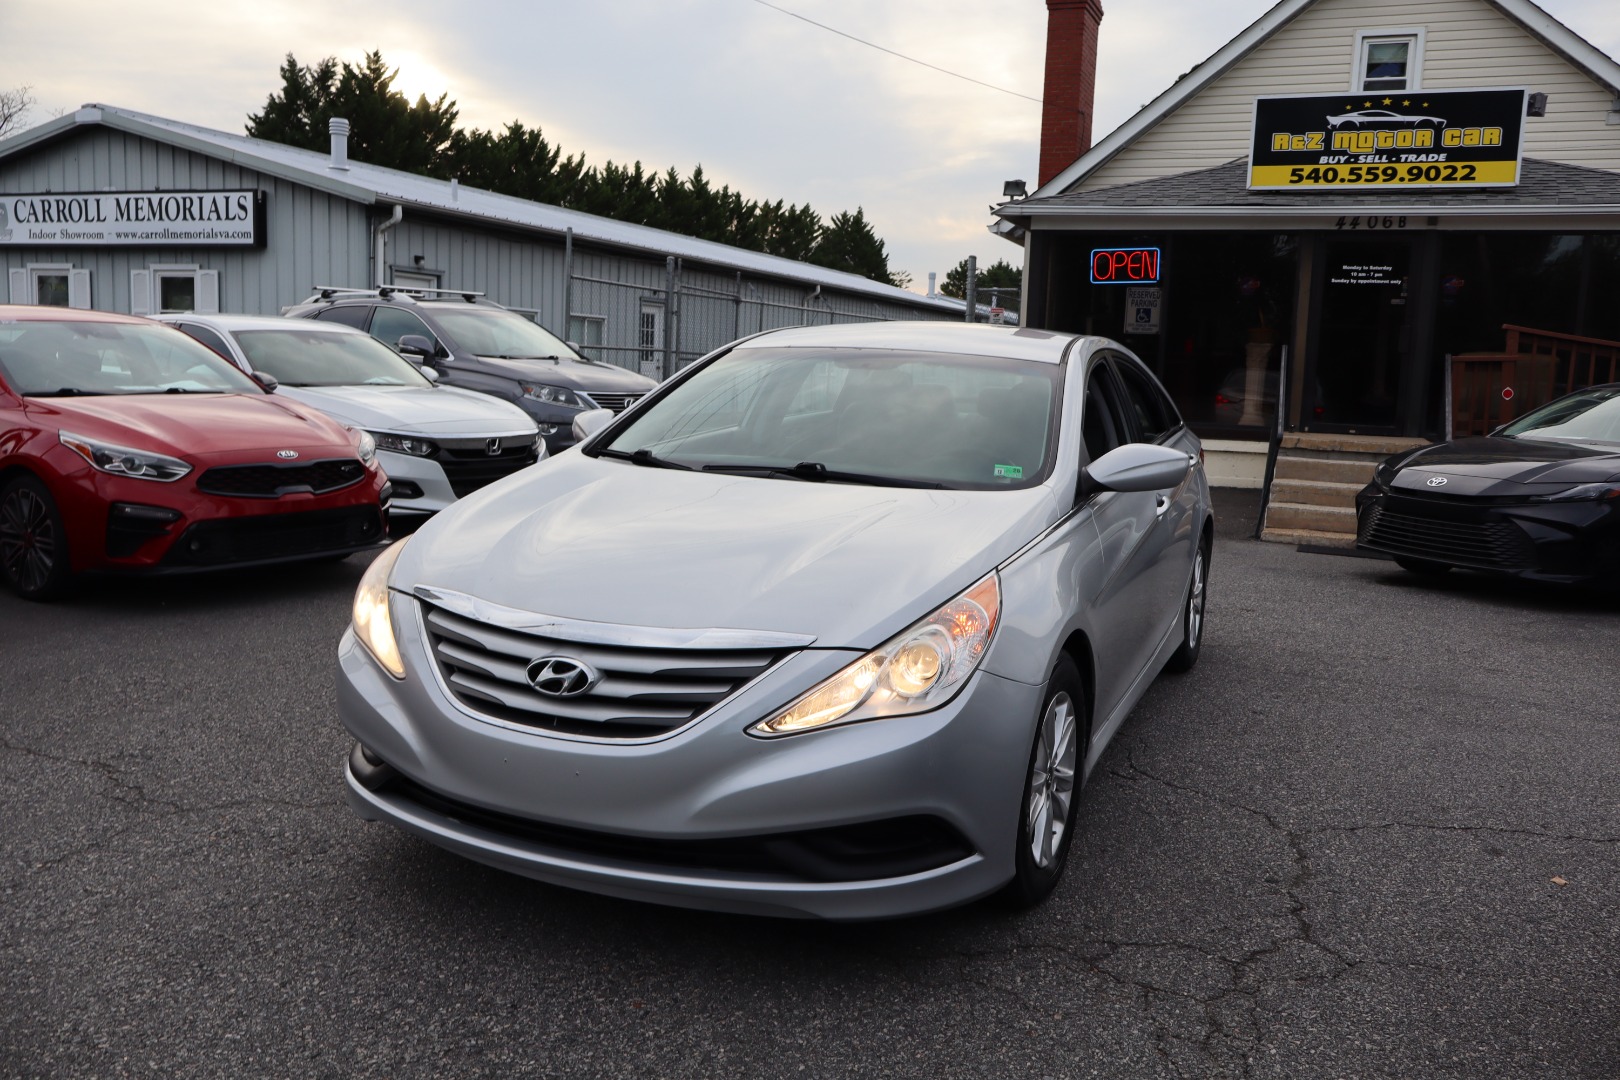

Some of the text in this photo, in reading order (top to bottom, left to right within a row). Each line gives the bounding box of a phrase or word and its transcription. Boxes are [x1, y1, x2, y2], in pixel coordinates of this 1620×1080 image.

[1319, 153, 1448, 164] BUY SELL TRADE
[1288, 165, 1477, 184] 540.559.9022
[13, 195, 248, 223] CARROLL MEMORIALS
[28, 228, 57, 240] Indoor
[60, 228, 104, 240] Showroom
[115, 228, 252, 240] www.carrollmemorialsva.com
[1093, 251, 1157, 280] OPEN
[1129, 290, 1160, 300] RESERVED
[1130, 299, 1157, 308] PARKING
